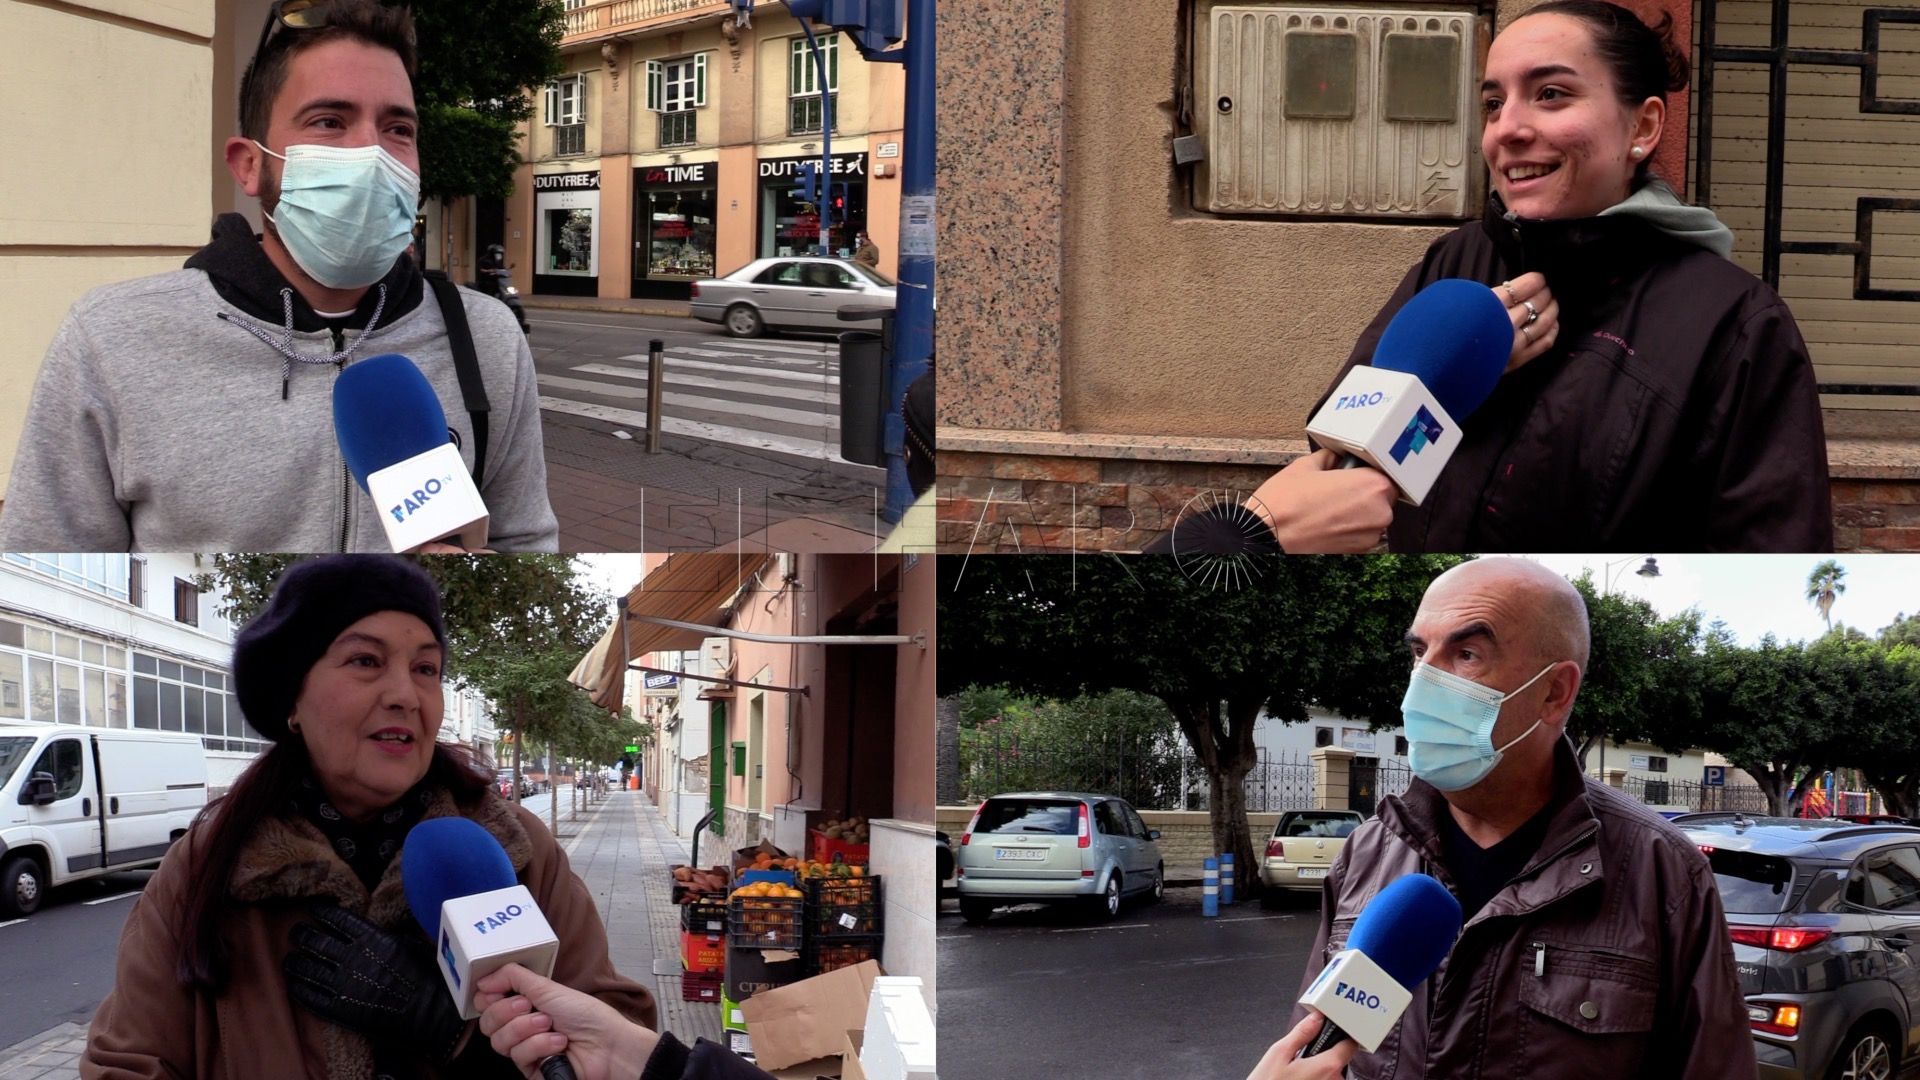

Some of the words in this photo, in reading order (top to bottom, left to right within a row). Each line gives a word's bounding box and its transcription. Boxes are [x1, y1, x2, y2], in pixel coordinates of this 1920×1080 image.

[536, 174, 590, 188] DUTYFREE
[1334, 391, 1383, 411] FARO
[390, 478, 442, 523] FARO
[646, 674, 674, 688] BEEP
[1707, 768, 1720, 784] P
[473, 904, 522, 935] FARO
[1335, 982, 1380, 1009] FARO
